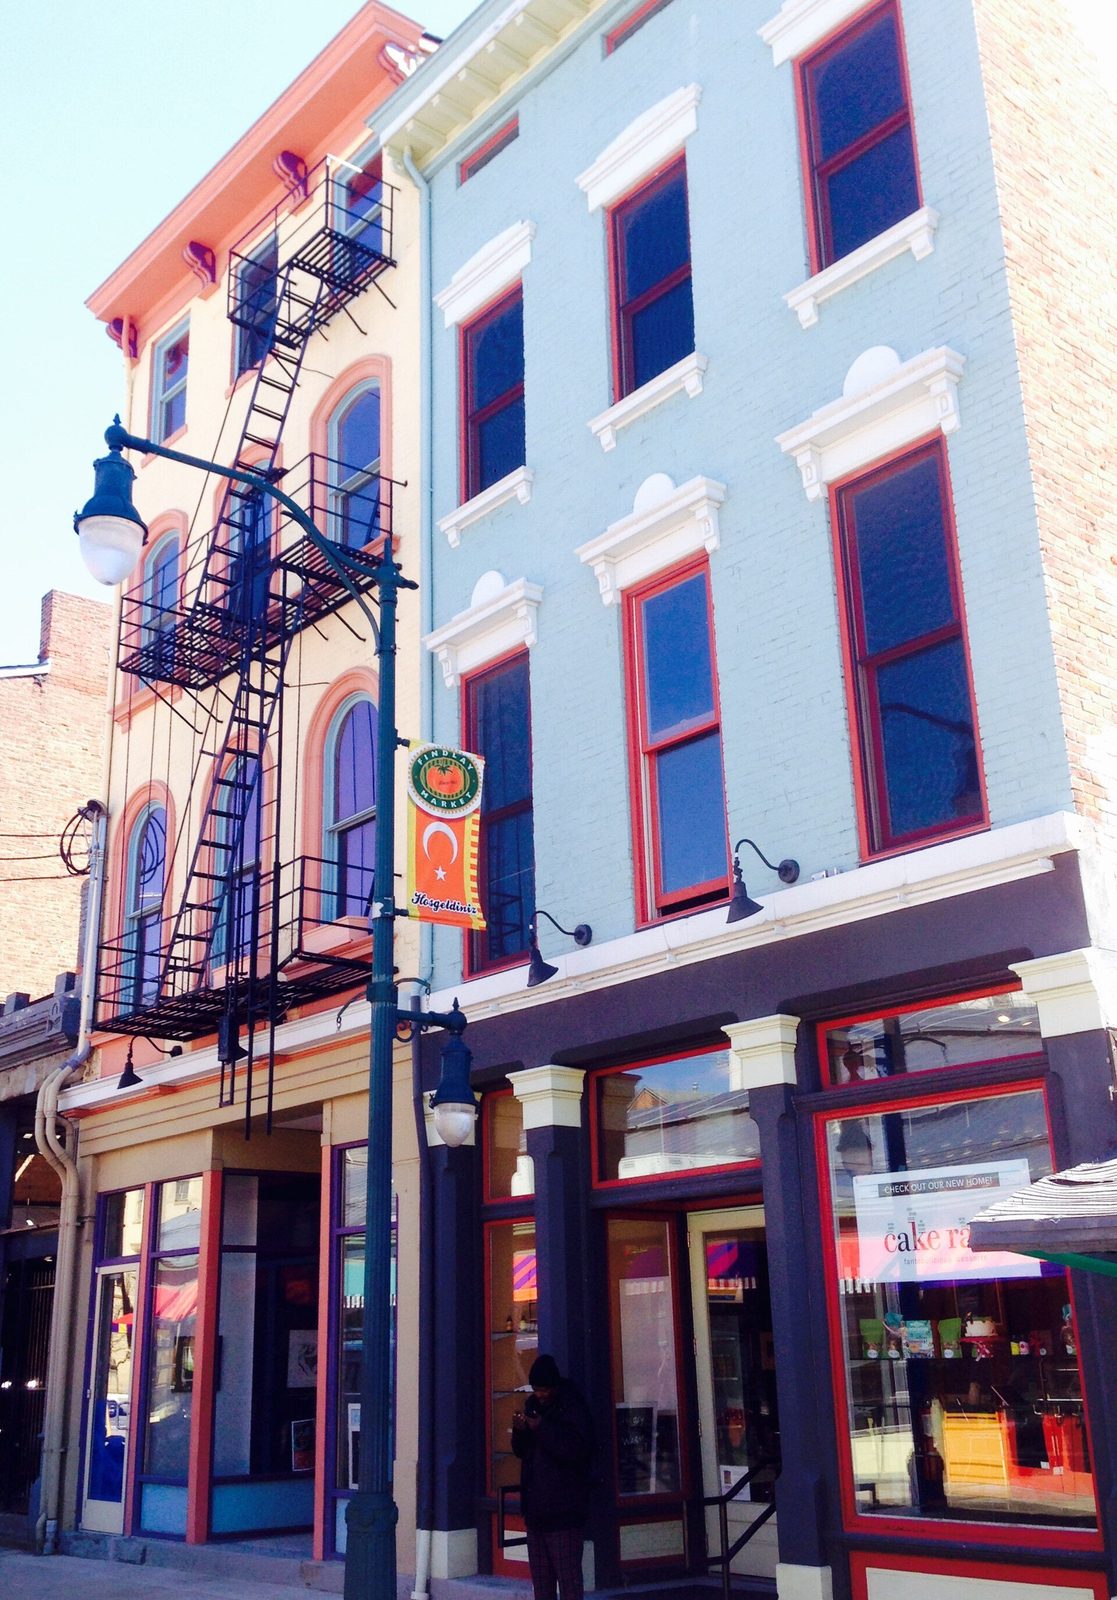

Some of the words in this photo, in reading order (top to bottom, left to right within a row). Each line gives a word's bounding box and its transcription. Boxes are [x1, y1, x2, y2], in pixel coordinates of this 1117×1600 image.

[417, 749, 474, 771] FINDLAY
[420, 791, 473, 809] MARKET
[884, 1184, 910, 1194] CHECK
[911, 1182, 926, 1192] OUT
[928, 1180, 945, 1190] OUR
[946, 1179, 964, 1188] NEW
[966, 1176, 993, 1186] HOME!
[884, 1221, 940, 1253] cake
[946, 1227, 971, 1250] ra
